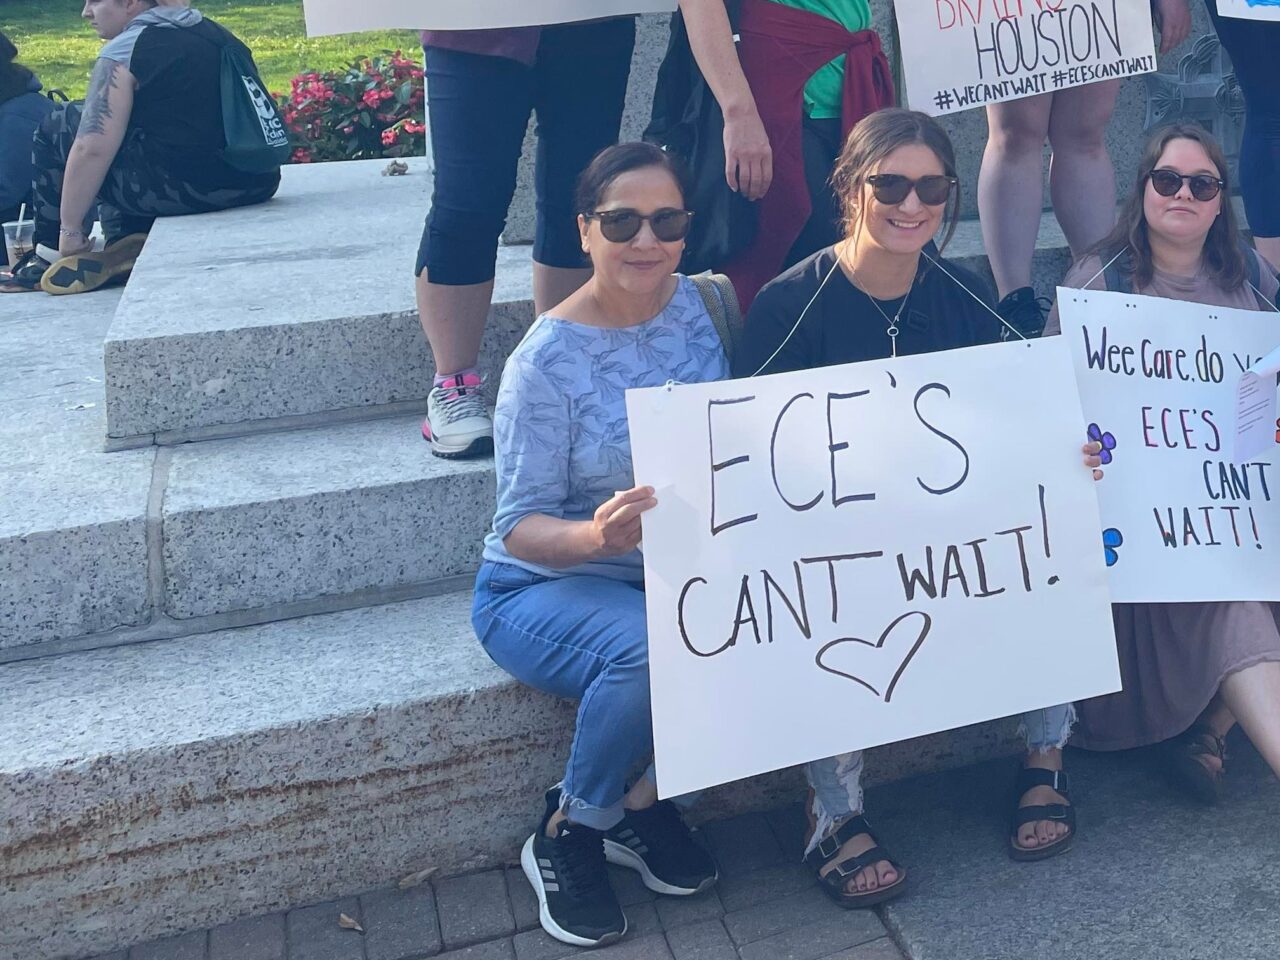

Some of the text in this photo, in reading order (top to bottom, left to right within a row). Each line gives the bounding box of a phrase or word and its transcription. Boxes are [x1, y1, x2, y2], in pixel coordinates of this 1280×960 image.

[934, 55, 1154, 110] #WECANTWAIT #ECESCANTWAIT
[1082, 324, 1135, 375] Wee
[1196, 335, 1224, 383] do
[707, 372, 970, 535] ECE'S
[1141, 407, 1220, 452] ECE'S
[1203, 460, 1271, 501] CAN'T
[1153, 506, 1262, 550] WAIT!
[678, 483, 1060, 657] CANT WAIT!
